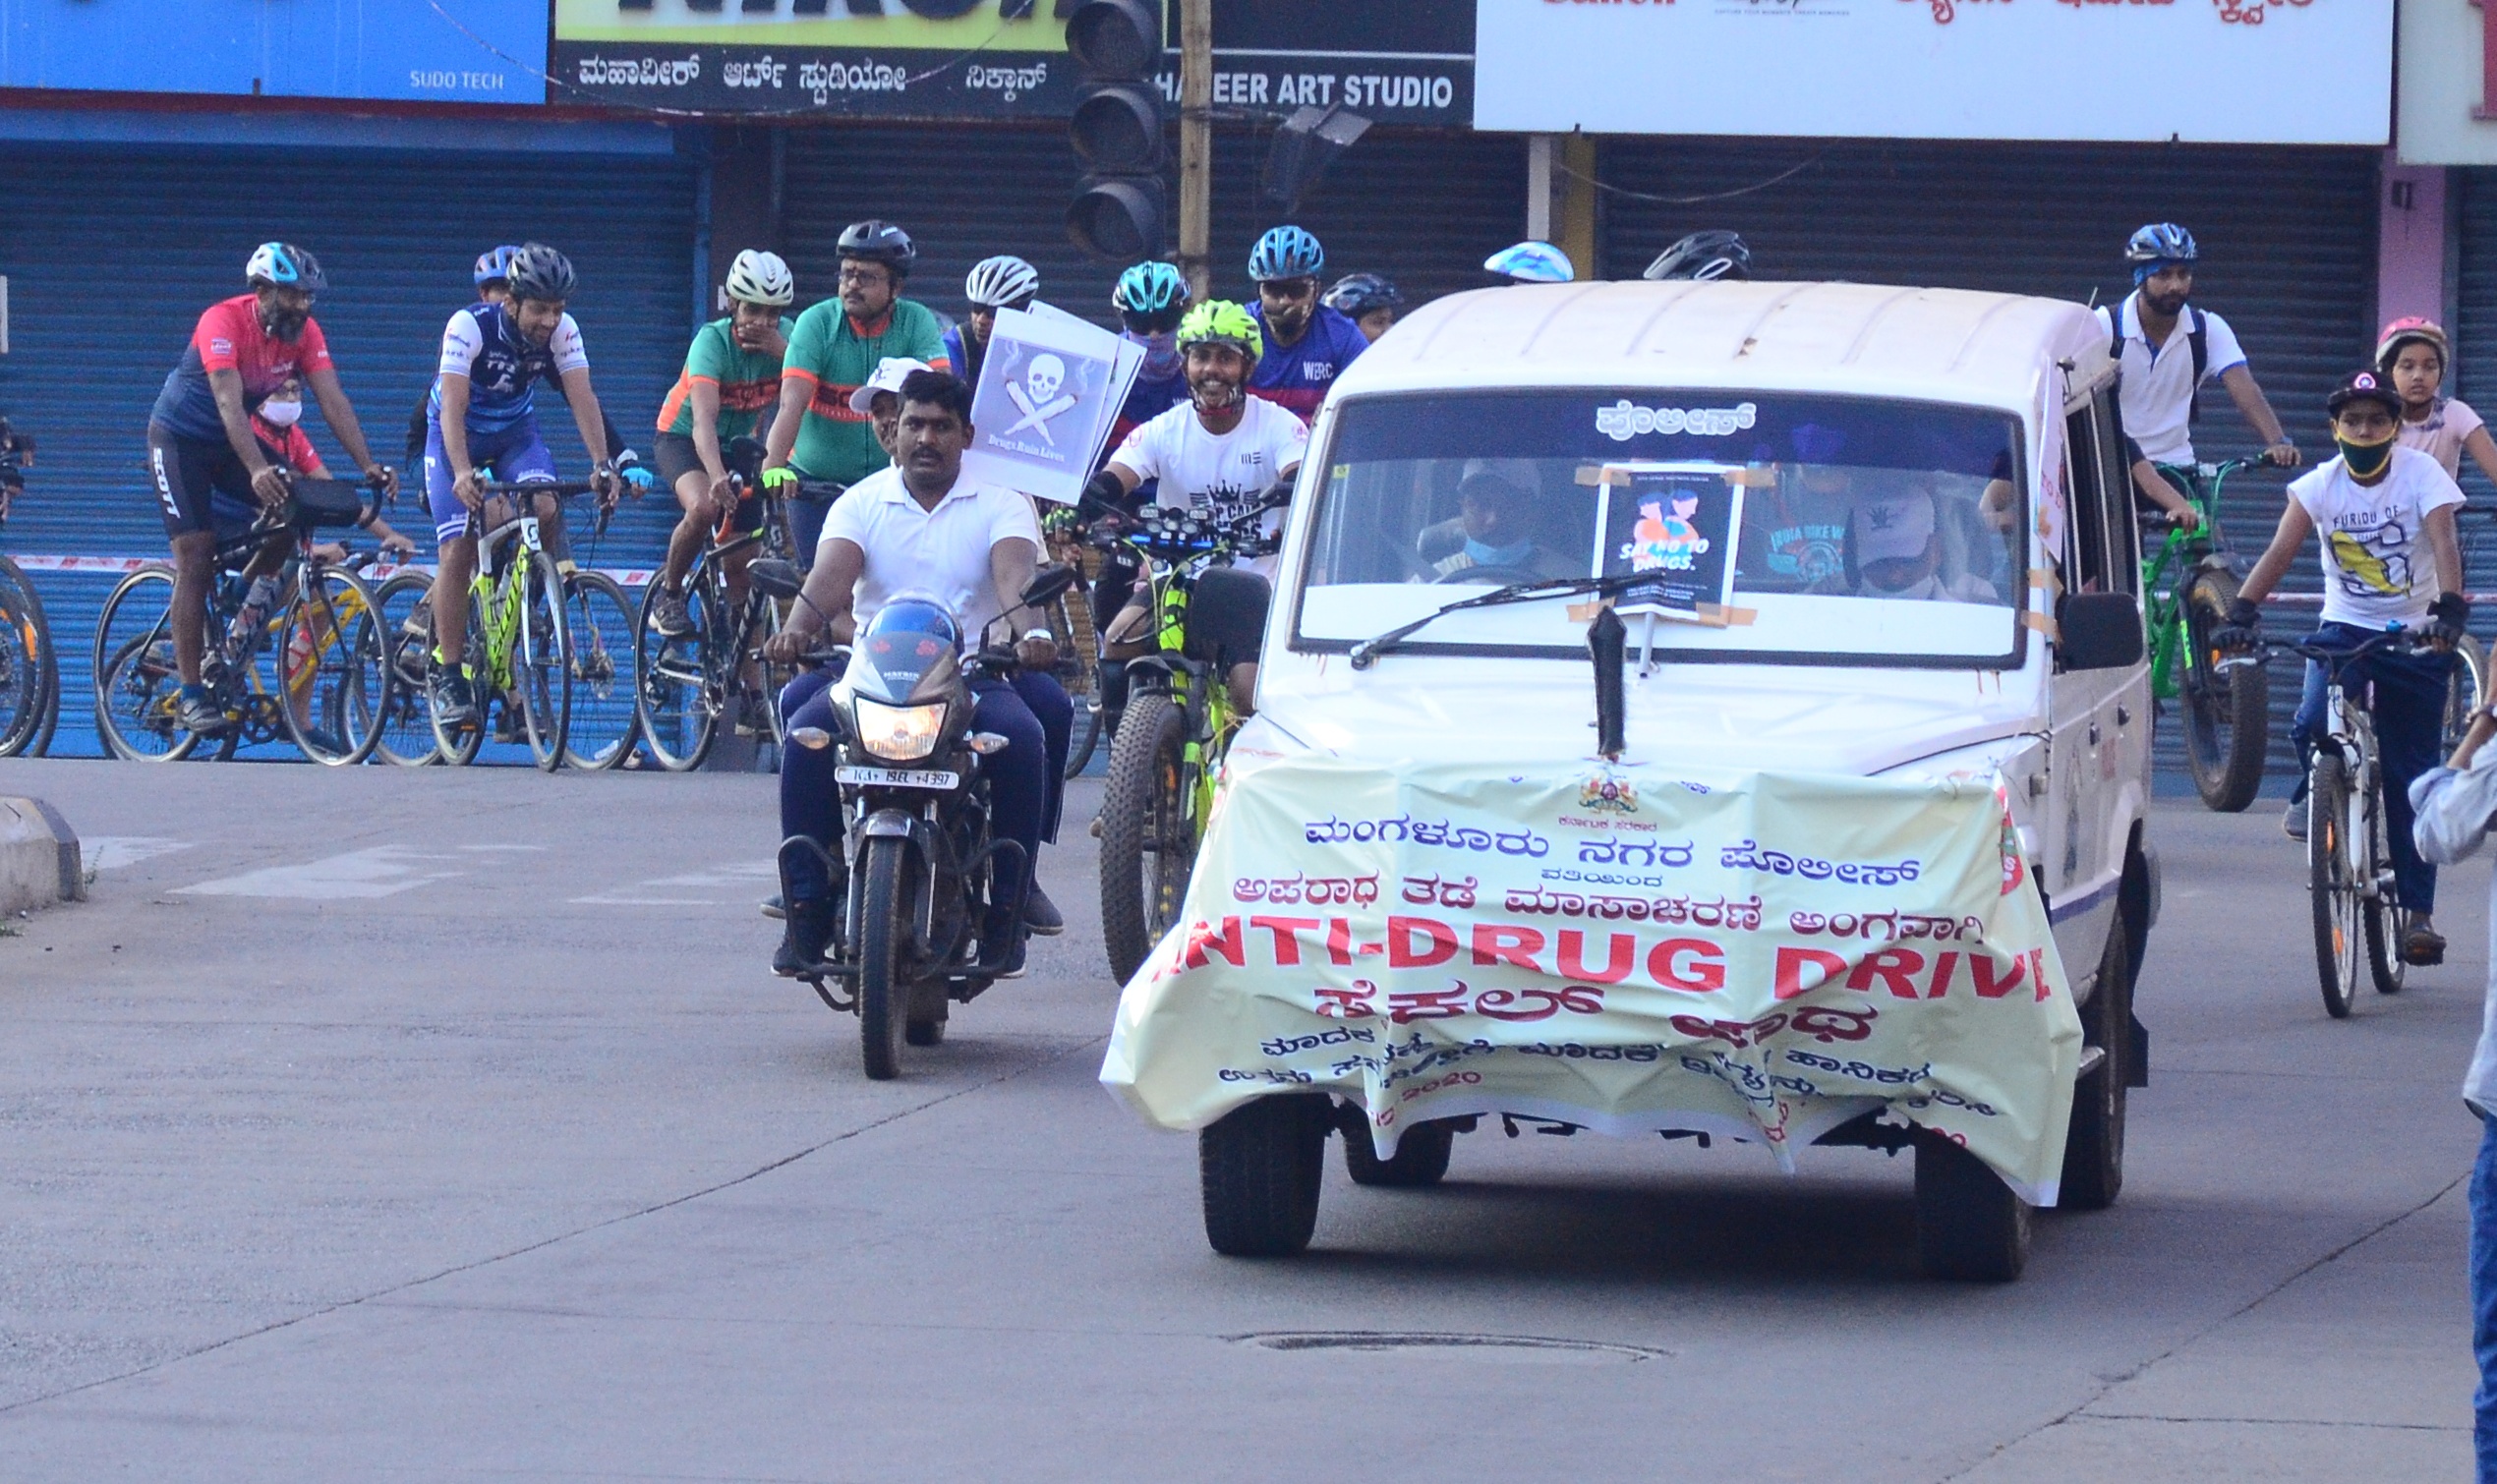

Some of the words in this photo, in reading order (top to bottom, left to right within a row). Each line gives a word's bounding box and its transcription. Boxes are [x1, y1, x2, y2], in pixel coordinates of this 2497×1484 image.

[410, 71, 456, 88] SUDO
[461, 72, 503, 89] TECH
[579, 54, 700, 87] ಮಹಾವೀರ್
[1277, 73, 1335, 105] ART
[1345, 75, 1453, 108] STUDIO
[988, 433, 1017, 452] Drugs
[1016, 441, 1041, 457] Ruin
[1040, 445, 1065, 463] Lives
[153, 447, 181, 519] SCOTT
[1655, 540, 1682, 557] NO
[1687, 538, 1710, 554] TO
[1305, 814, 1550, 859] ಮಂಗಳೂರು
[1578, 834, 1694, 869] ನಗರ
[1233, 869, 1380, 910] ಅಪರಾಧ
[1402, 872, 1479, 910] ತಡೆ
[1504, 883, 1763, 934] ಮಾಸಾಚರಣೆ
